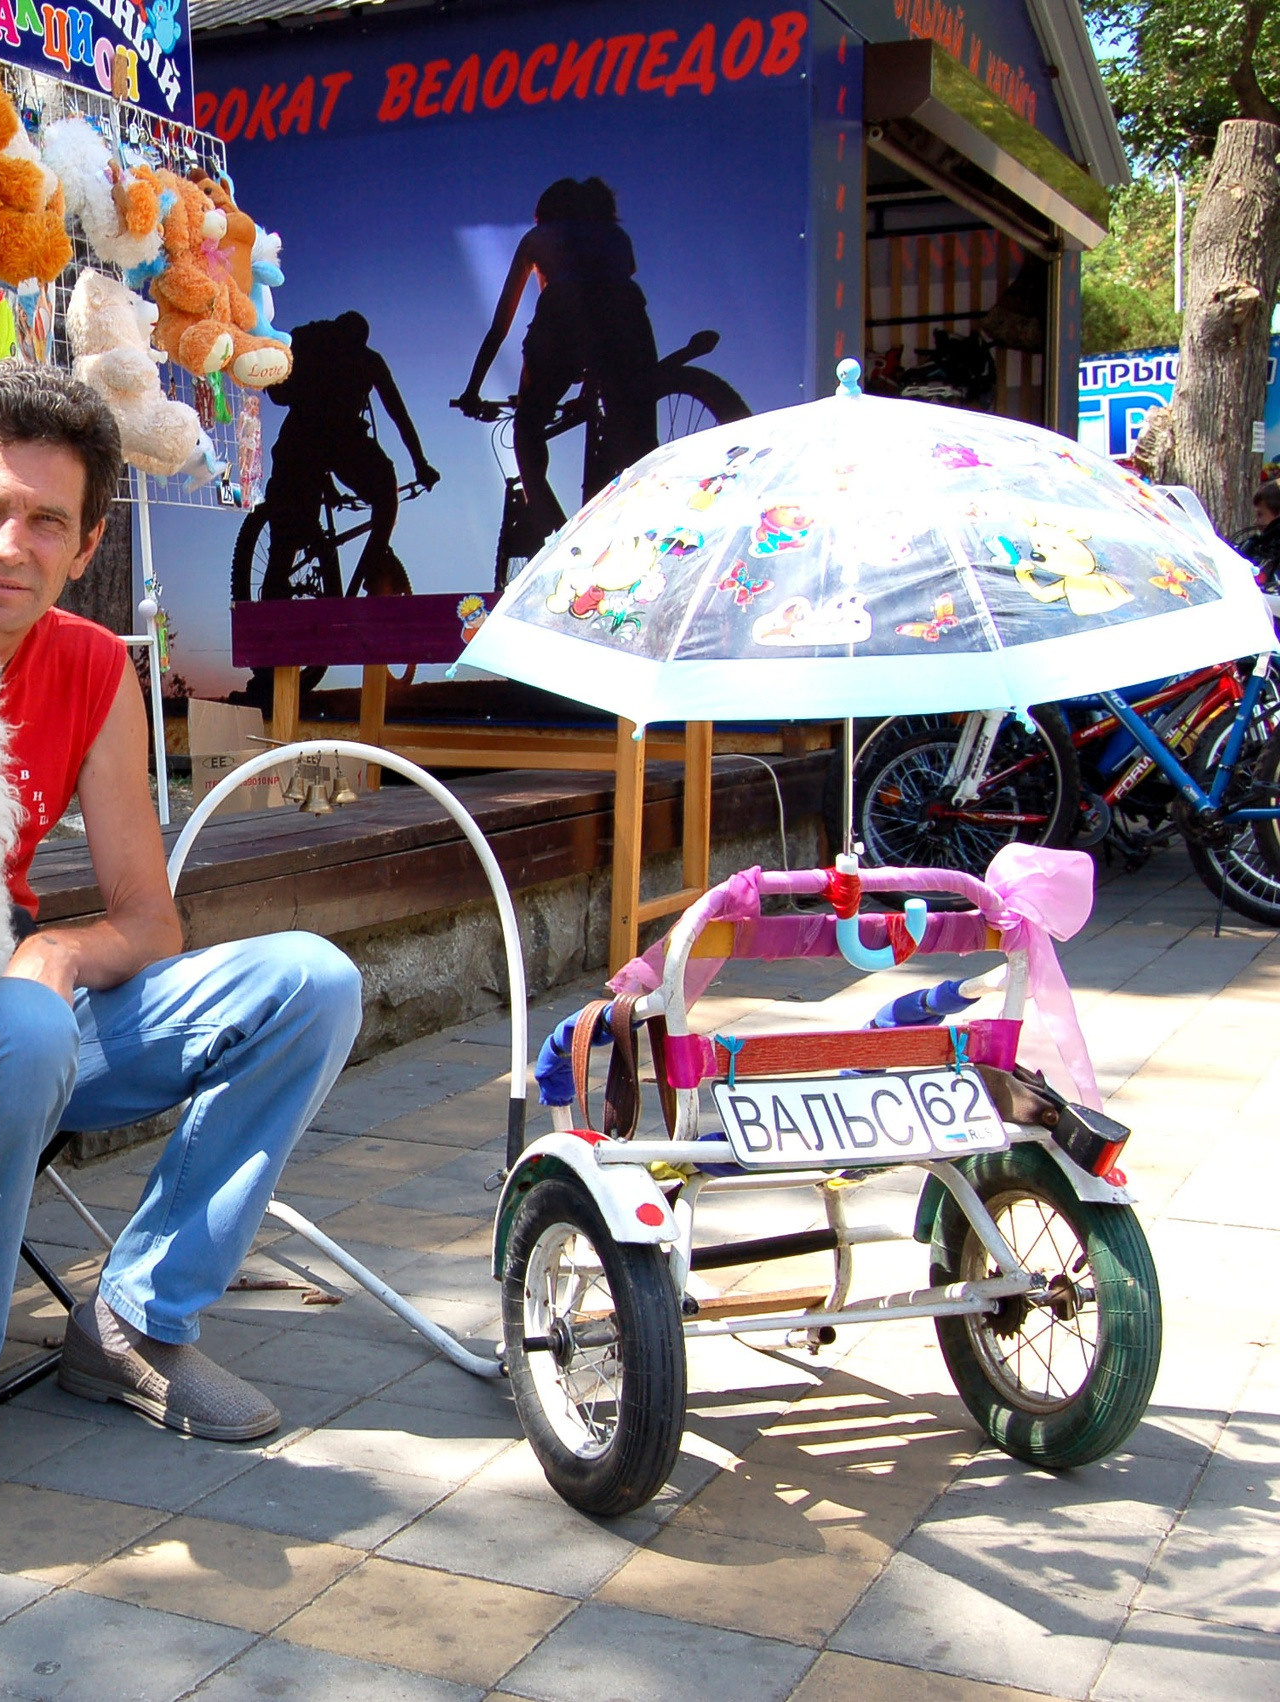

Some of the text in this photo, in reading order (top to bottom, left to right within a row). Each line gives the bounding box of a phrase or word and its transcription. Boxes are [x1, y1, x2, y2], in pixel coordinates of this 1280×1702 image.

[969, 33, 982, 77] И
[154, 10, 809, 150] РОКАТ ВЕЛОСИПЕДОВ
[248, 363, 284, 378] Love
[211, 756, 227, 768] EE
[1114, 755, 1154, 800] FORW
[728, 1078, 991, 1153] ВАЛЬС 62
